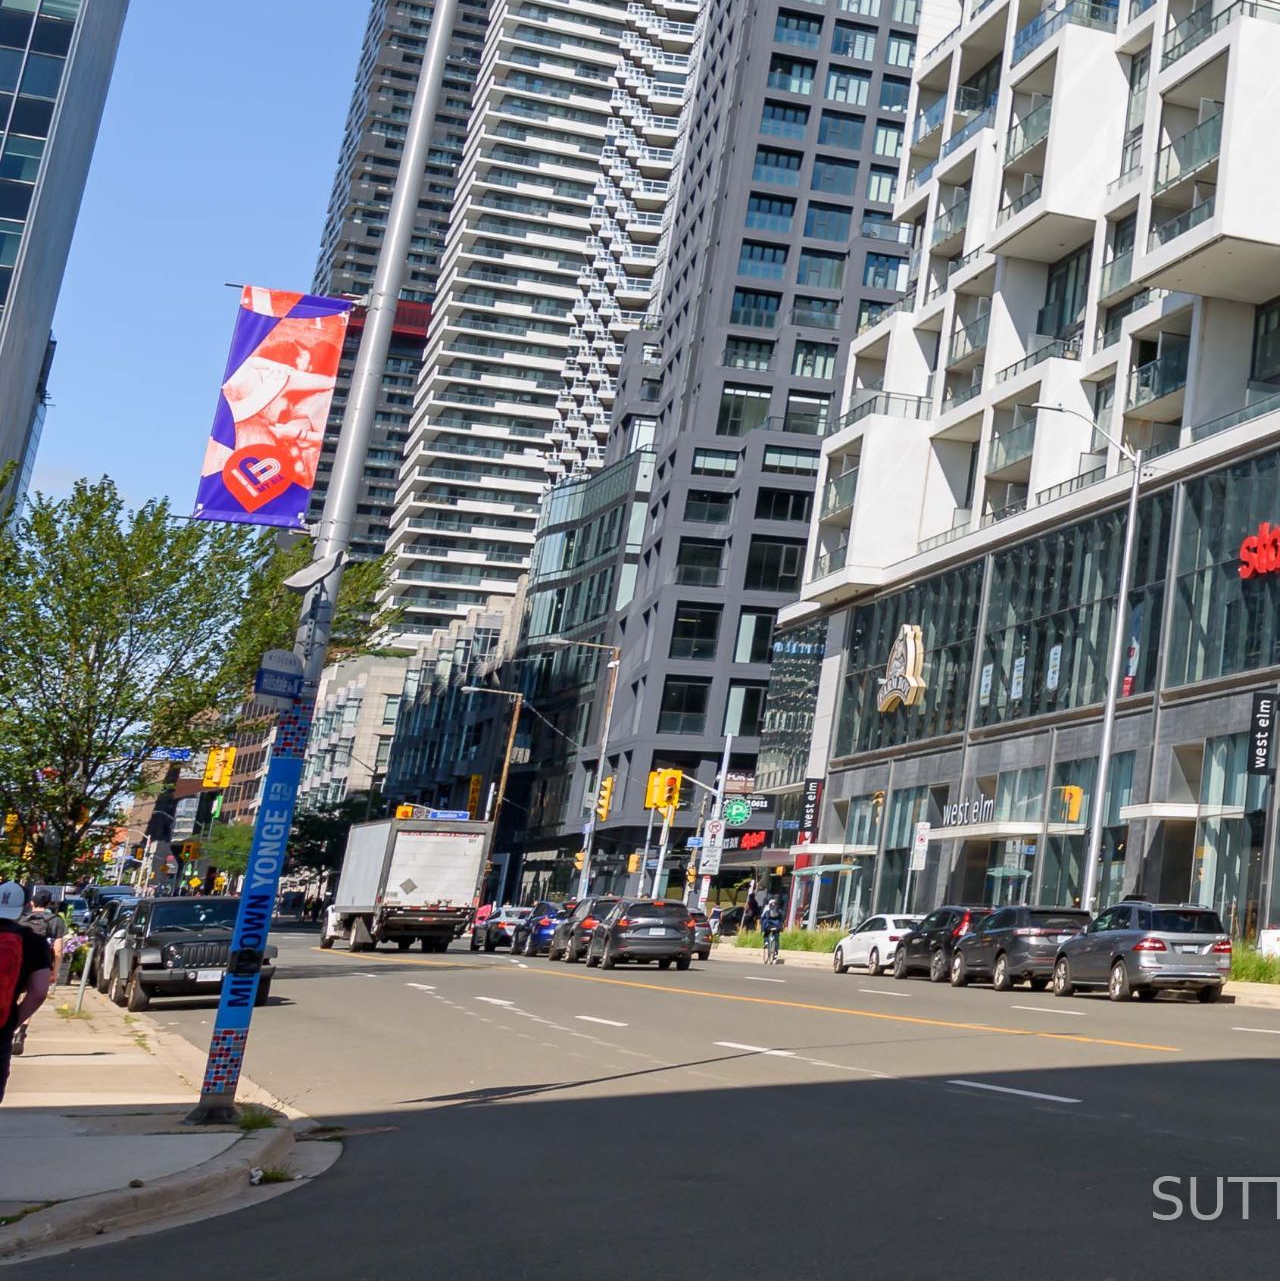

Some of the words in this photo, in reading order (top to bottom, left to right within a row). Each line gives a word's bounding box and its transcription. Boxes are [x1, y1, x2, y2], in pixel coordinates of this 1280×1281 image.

[1256, 699, 1271, 727] elm
[1255, 732, 1268, 768] west
[807, 782, 818, 801] elm
[804, 803, 815, 828] west
[943, 797, 969, 826] west
[972, 793, 994, 823] elm
[228, 894, 270, 1007] MIOWN
[251, 809, 288, 888] YONGE
